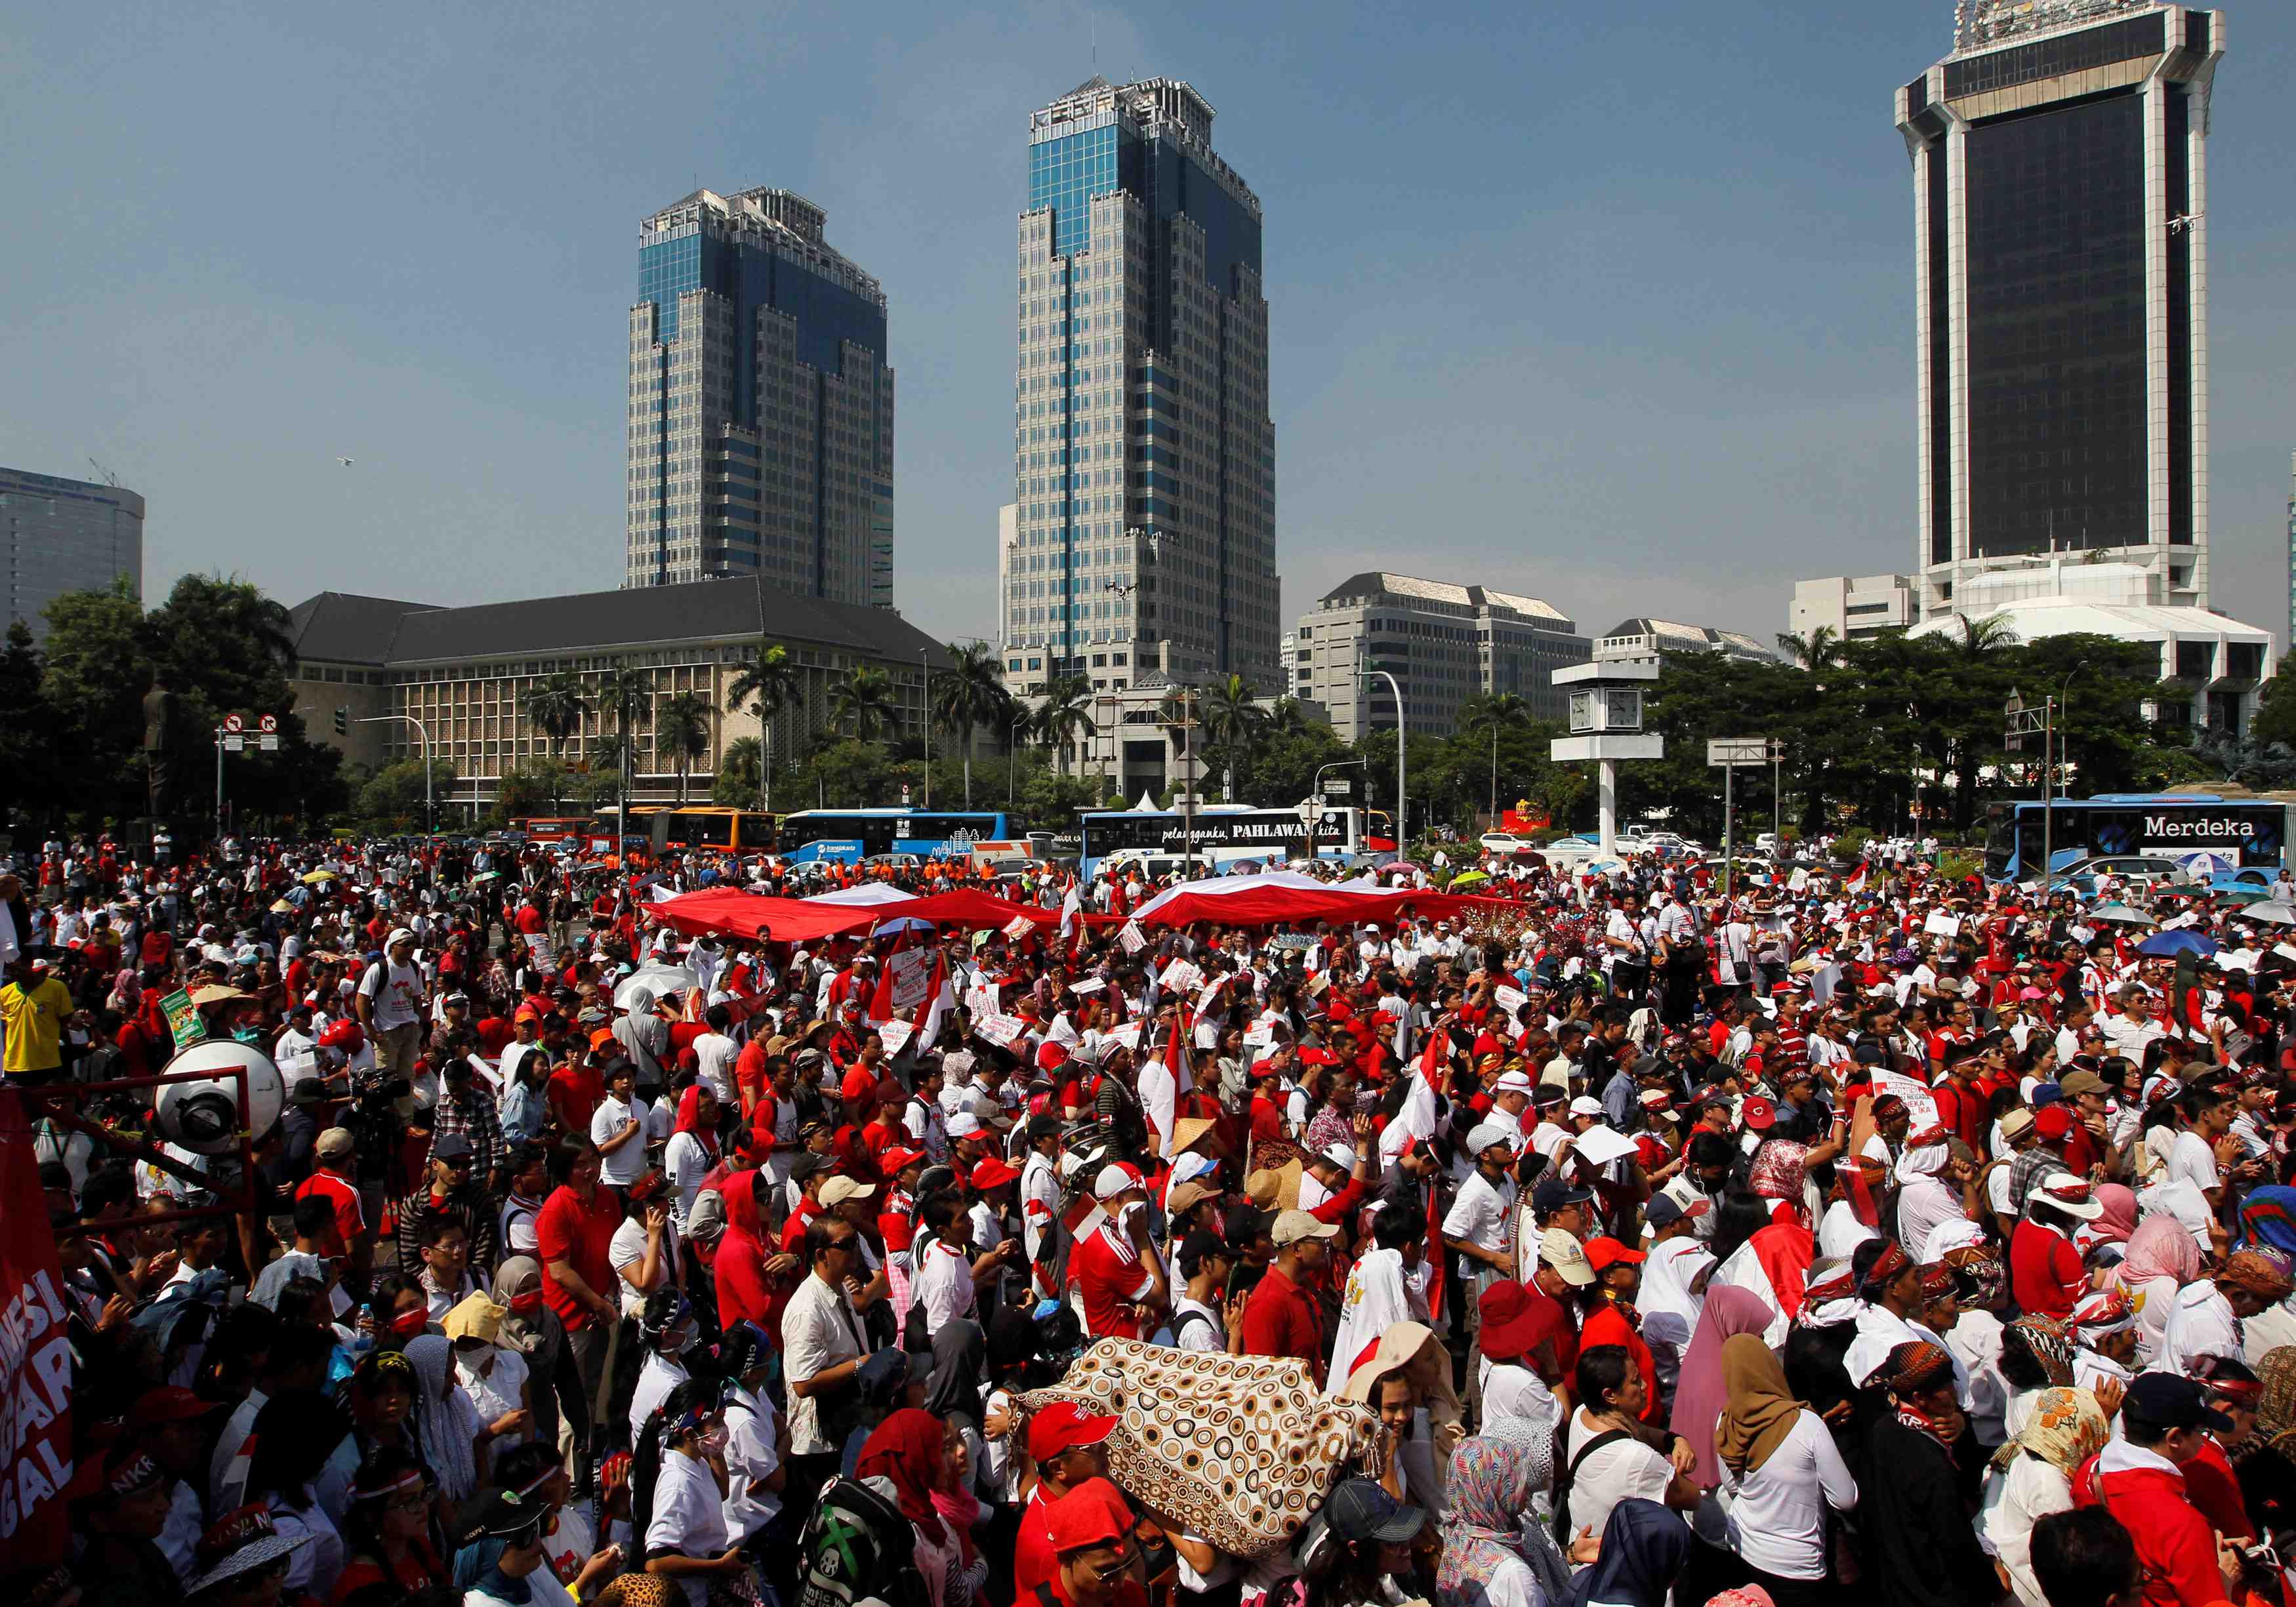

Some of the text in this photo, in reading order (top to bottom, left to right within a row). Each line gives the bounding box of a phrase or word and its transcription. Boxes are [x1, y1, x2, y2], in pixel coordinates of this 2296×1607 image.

[1233, 824, 1313, 837] PAHLAWAN
[1318, 823, 1341, 836] kita
[2144, 817, 2255, 836] Merdeka
